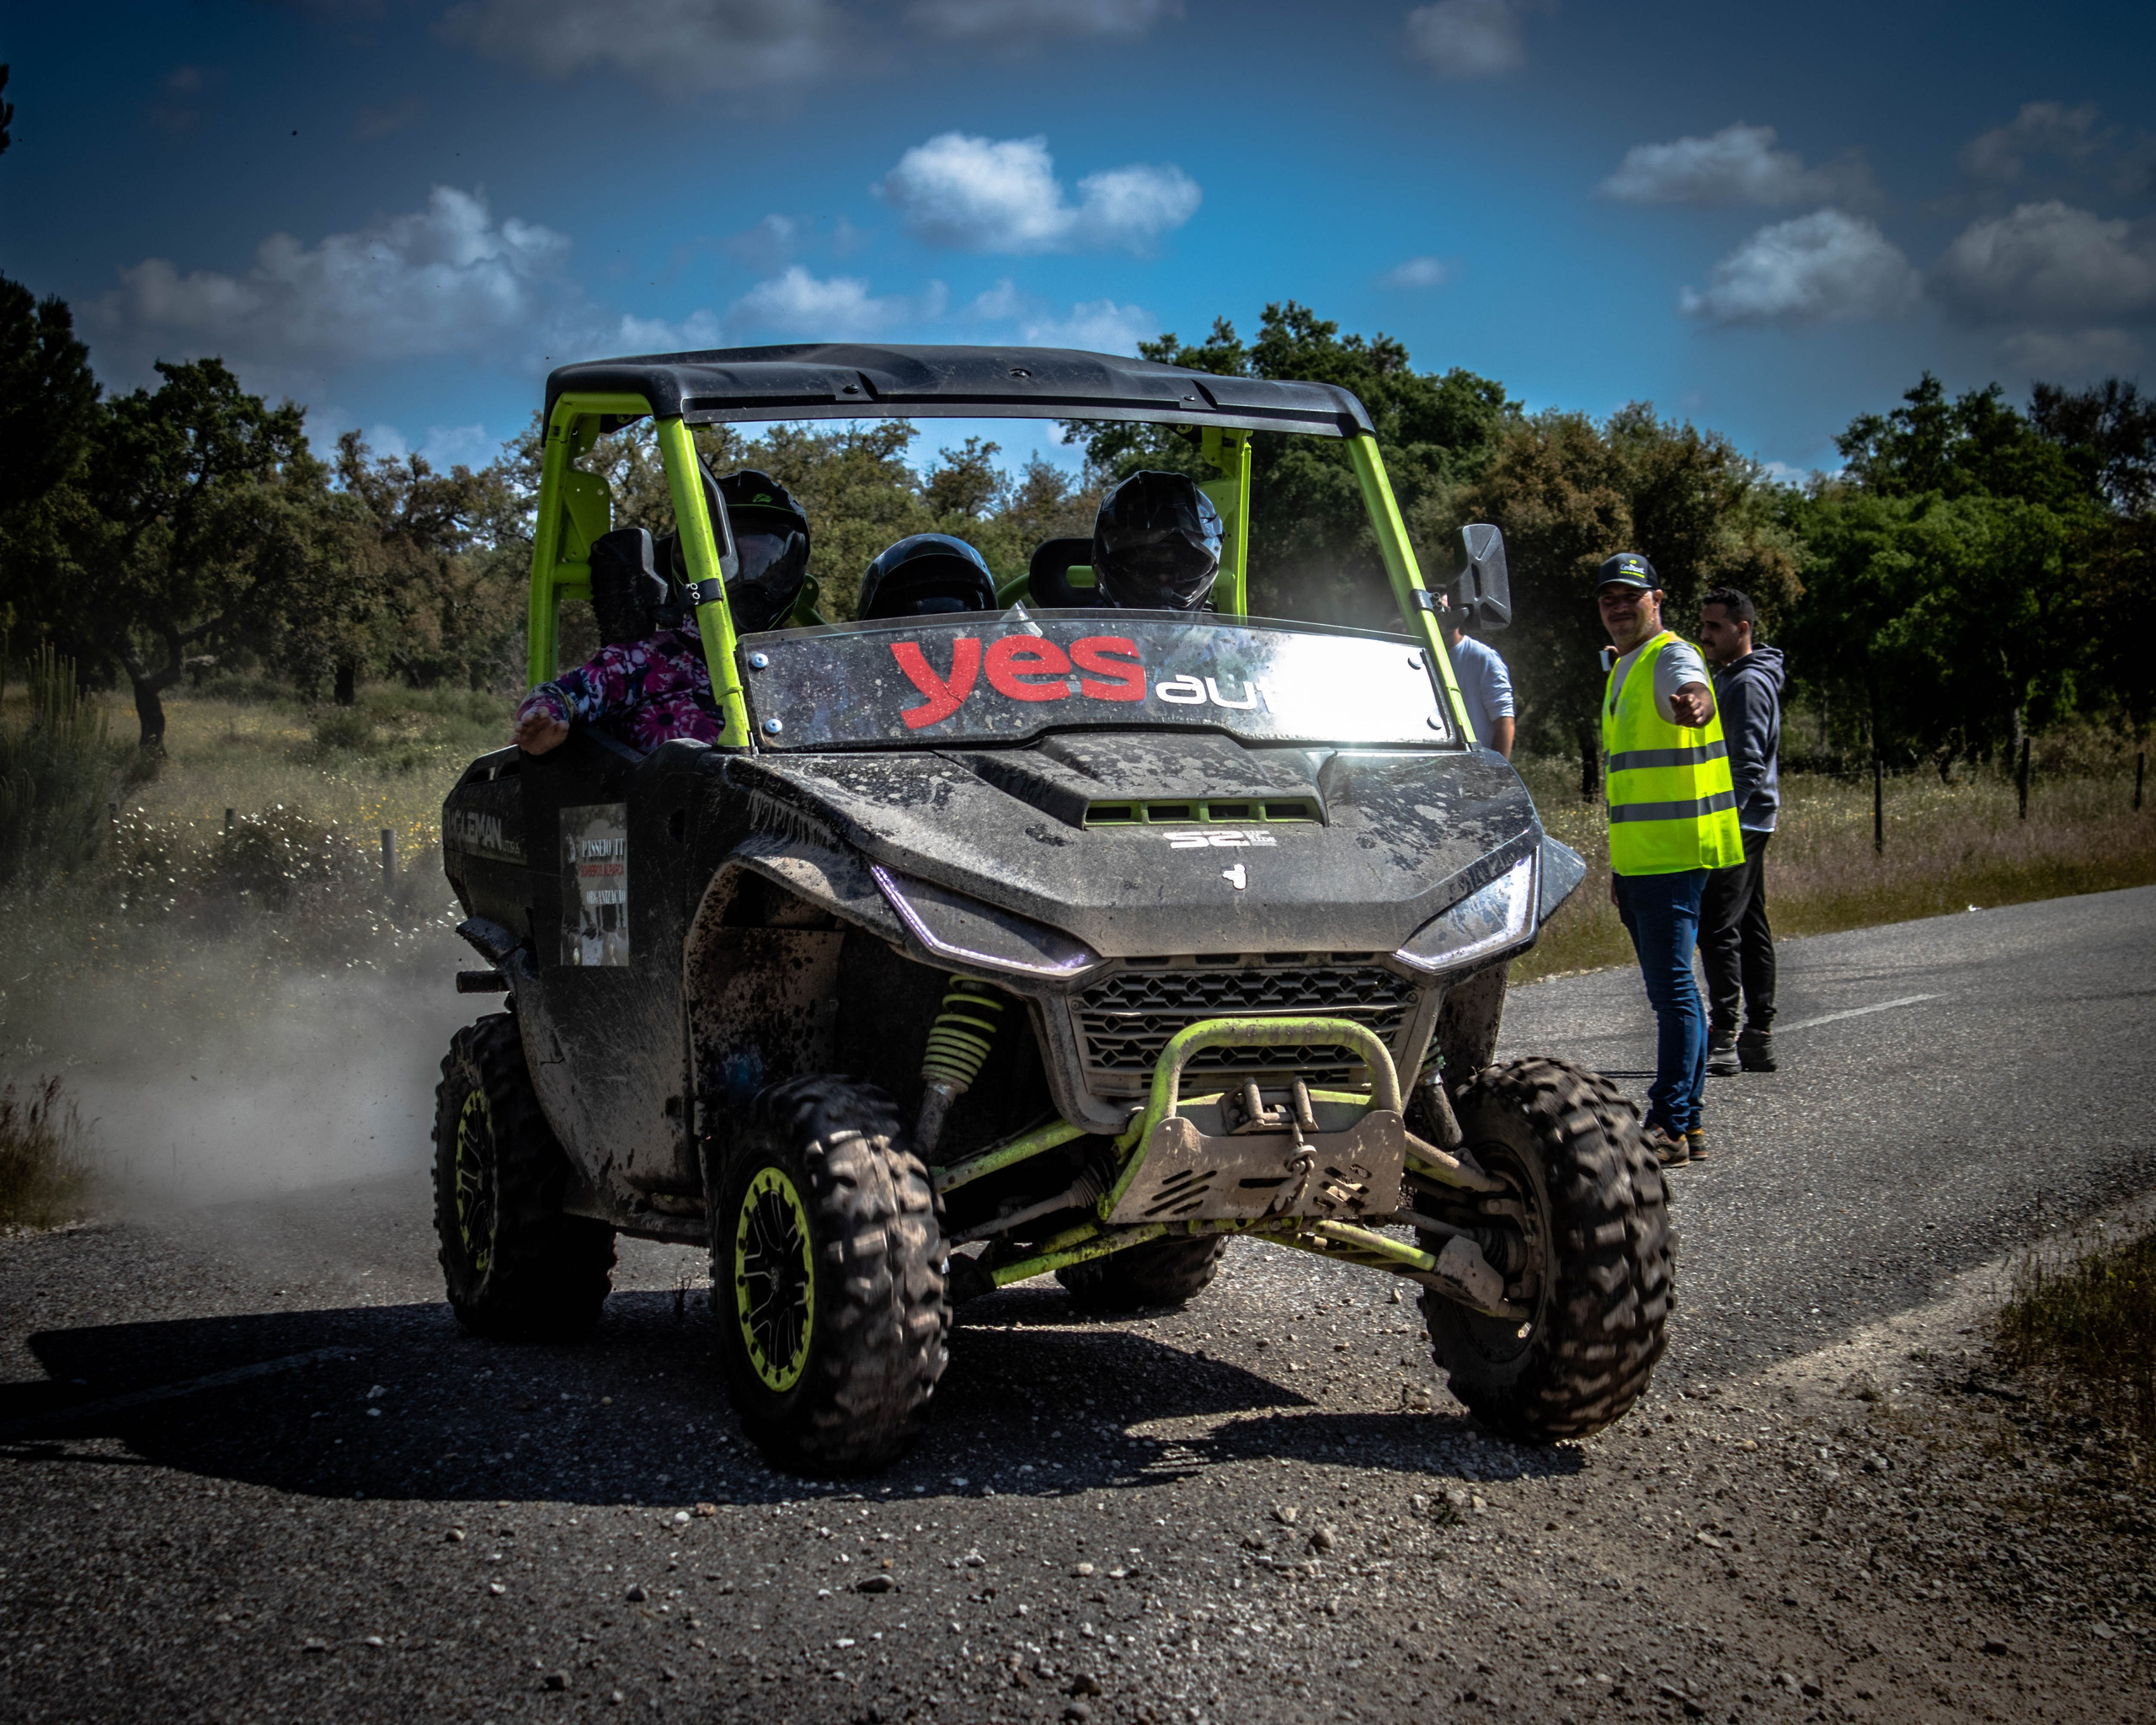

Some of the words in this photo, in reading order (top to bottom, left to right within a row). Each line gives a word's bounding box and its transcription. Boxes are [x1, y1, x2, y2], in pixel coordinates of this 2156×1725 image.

[890, 634, 1146, 729] yes
[1155, 674, 1278, 714] aut
[582, 838, 612, 857] PASSEIO
[614, 838, 624, 856] TT
